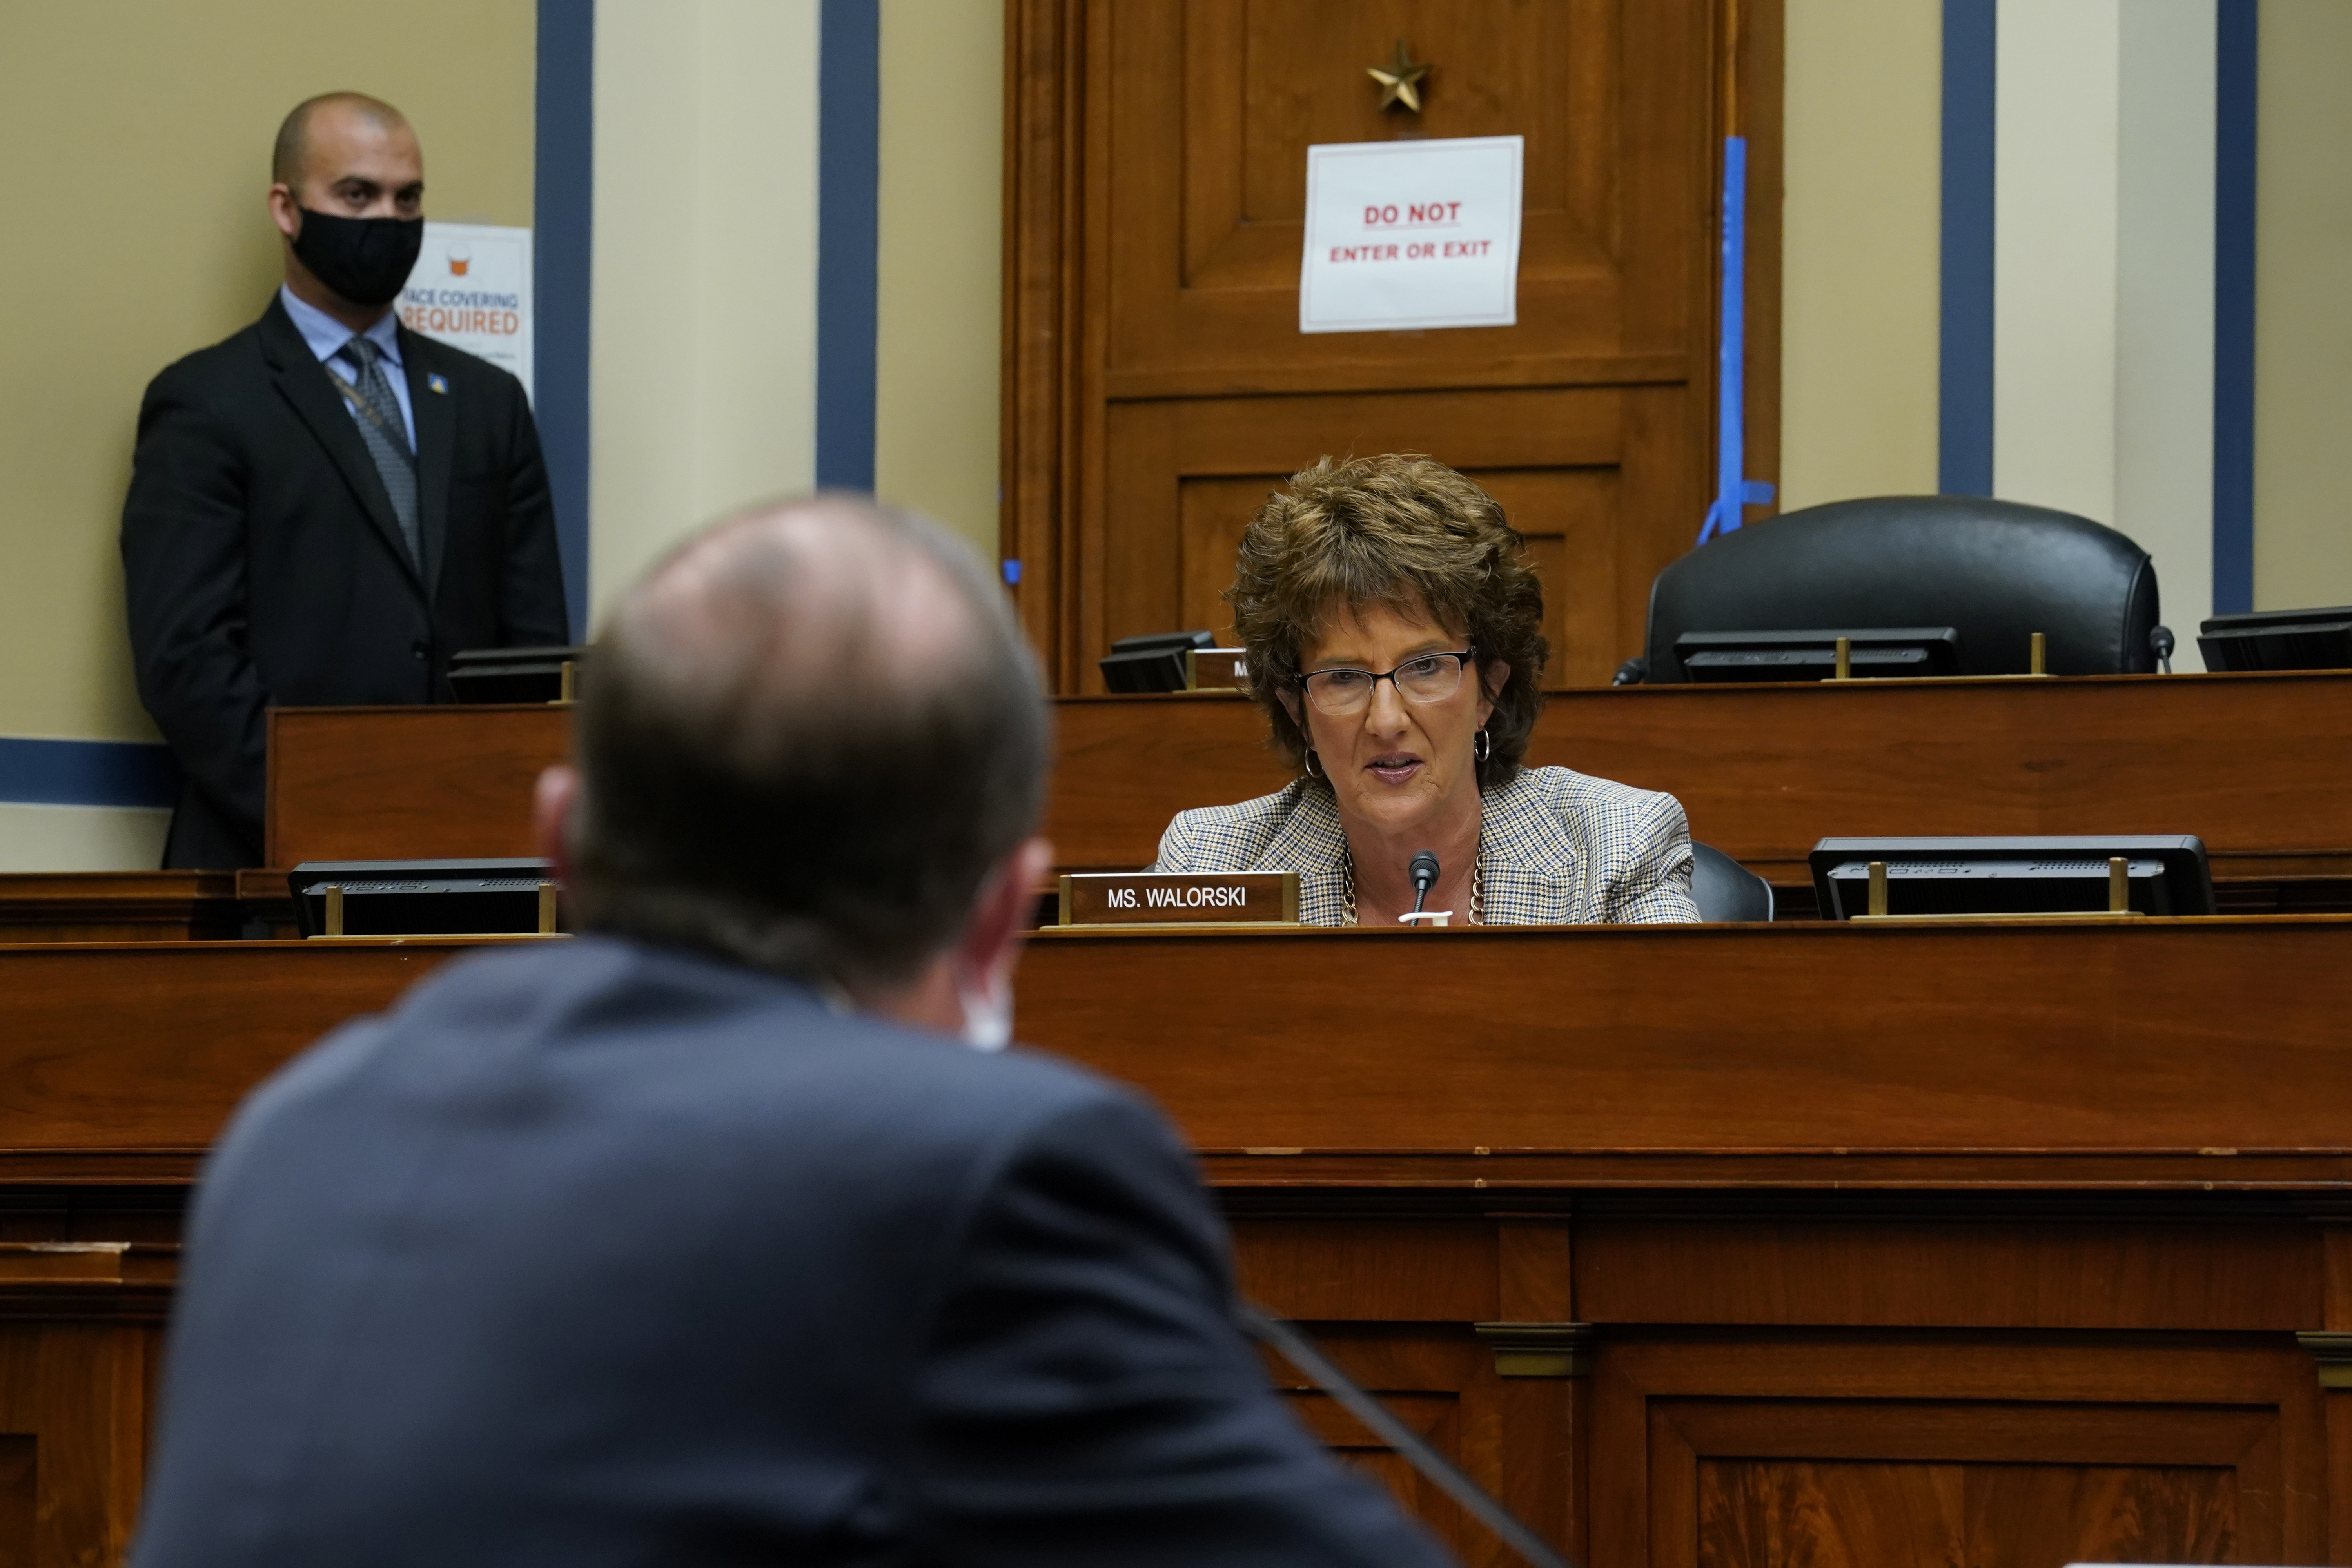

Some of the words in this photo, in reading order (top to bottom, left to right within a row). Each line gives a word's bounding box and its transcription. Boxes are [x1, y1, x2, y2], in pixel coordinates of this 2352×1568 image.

[1364, 205, 1399, 224] DO
[1408, 201, 1461, 222] NOT
[1330, 244, 1399, 263] ENTER
[1406, 242, 1435, 258] OR
[1444, 240, 1491, 258] EXIT
[439, 289, 518, 309] COVERING
[404, 305, 518, 334] REQUIRED
[1108, 888, 1140, 908] MS.
[1146, 887, 1245, 907] WALORSKI
